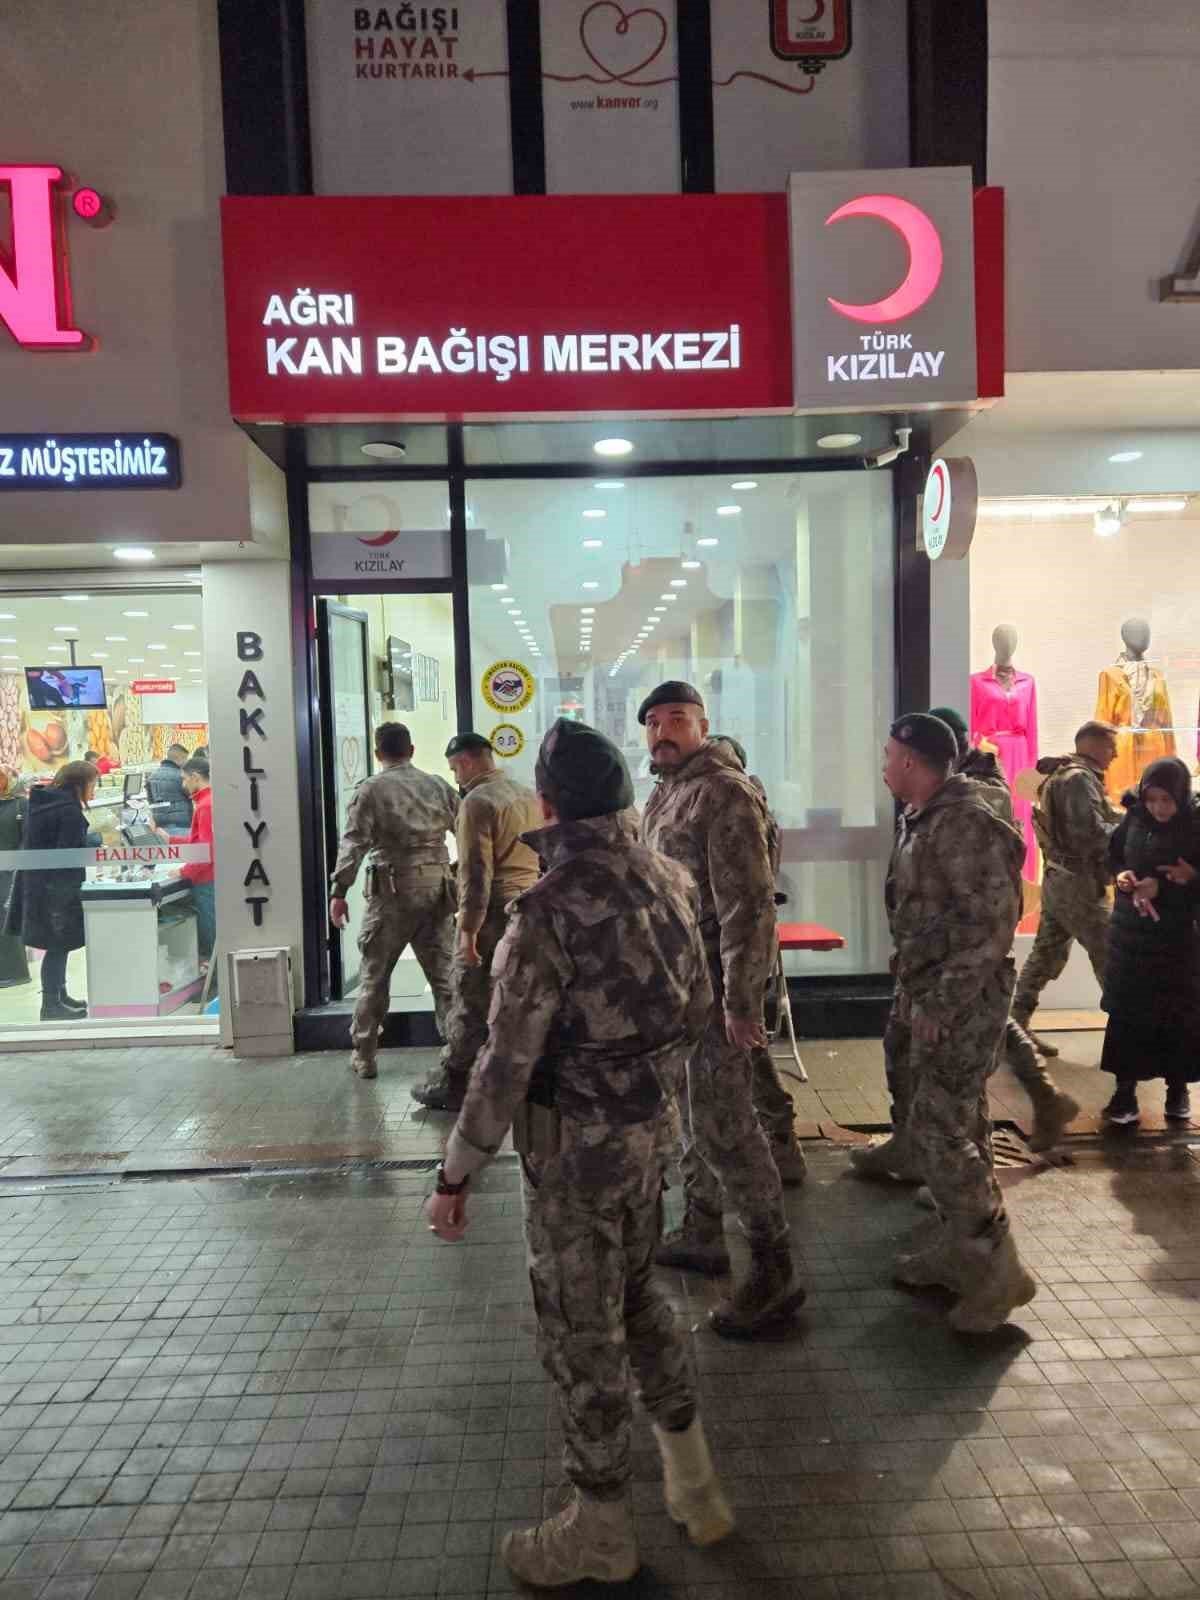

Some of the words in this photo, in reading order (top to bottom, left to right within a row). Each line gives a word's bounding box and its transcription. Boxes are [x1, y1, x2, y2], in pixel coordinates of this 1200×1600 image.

[354, 2, 459, 36] BAĞIŞI
[354, 37, 459, 59] HAYAT
[355, 63, 458, 79] KURTARIR
[262, 287, 354, 326] AĞRI
[266, 336, 363, 375] KAN
[376, 327, 529, 382] BAĞIŞI
[543, 323, 740, 372] MERKEZİ
[859, 330, 913, 350] TÜRK
[827, 351, 945, 381] KIZILAY
[21, 438, 168, 482] MÜŞTERİMİZ
[354, 560, 405, 572] KIZILAY
[236, 631, 271, 927] BAKLİYAT
[96, 846, 180, 862] HALKTAN
